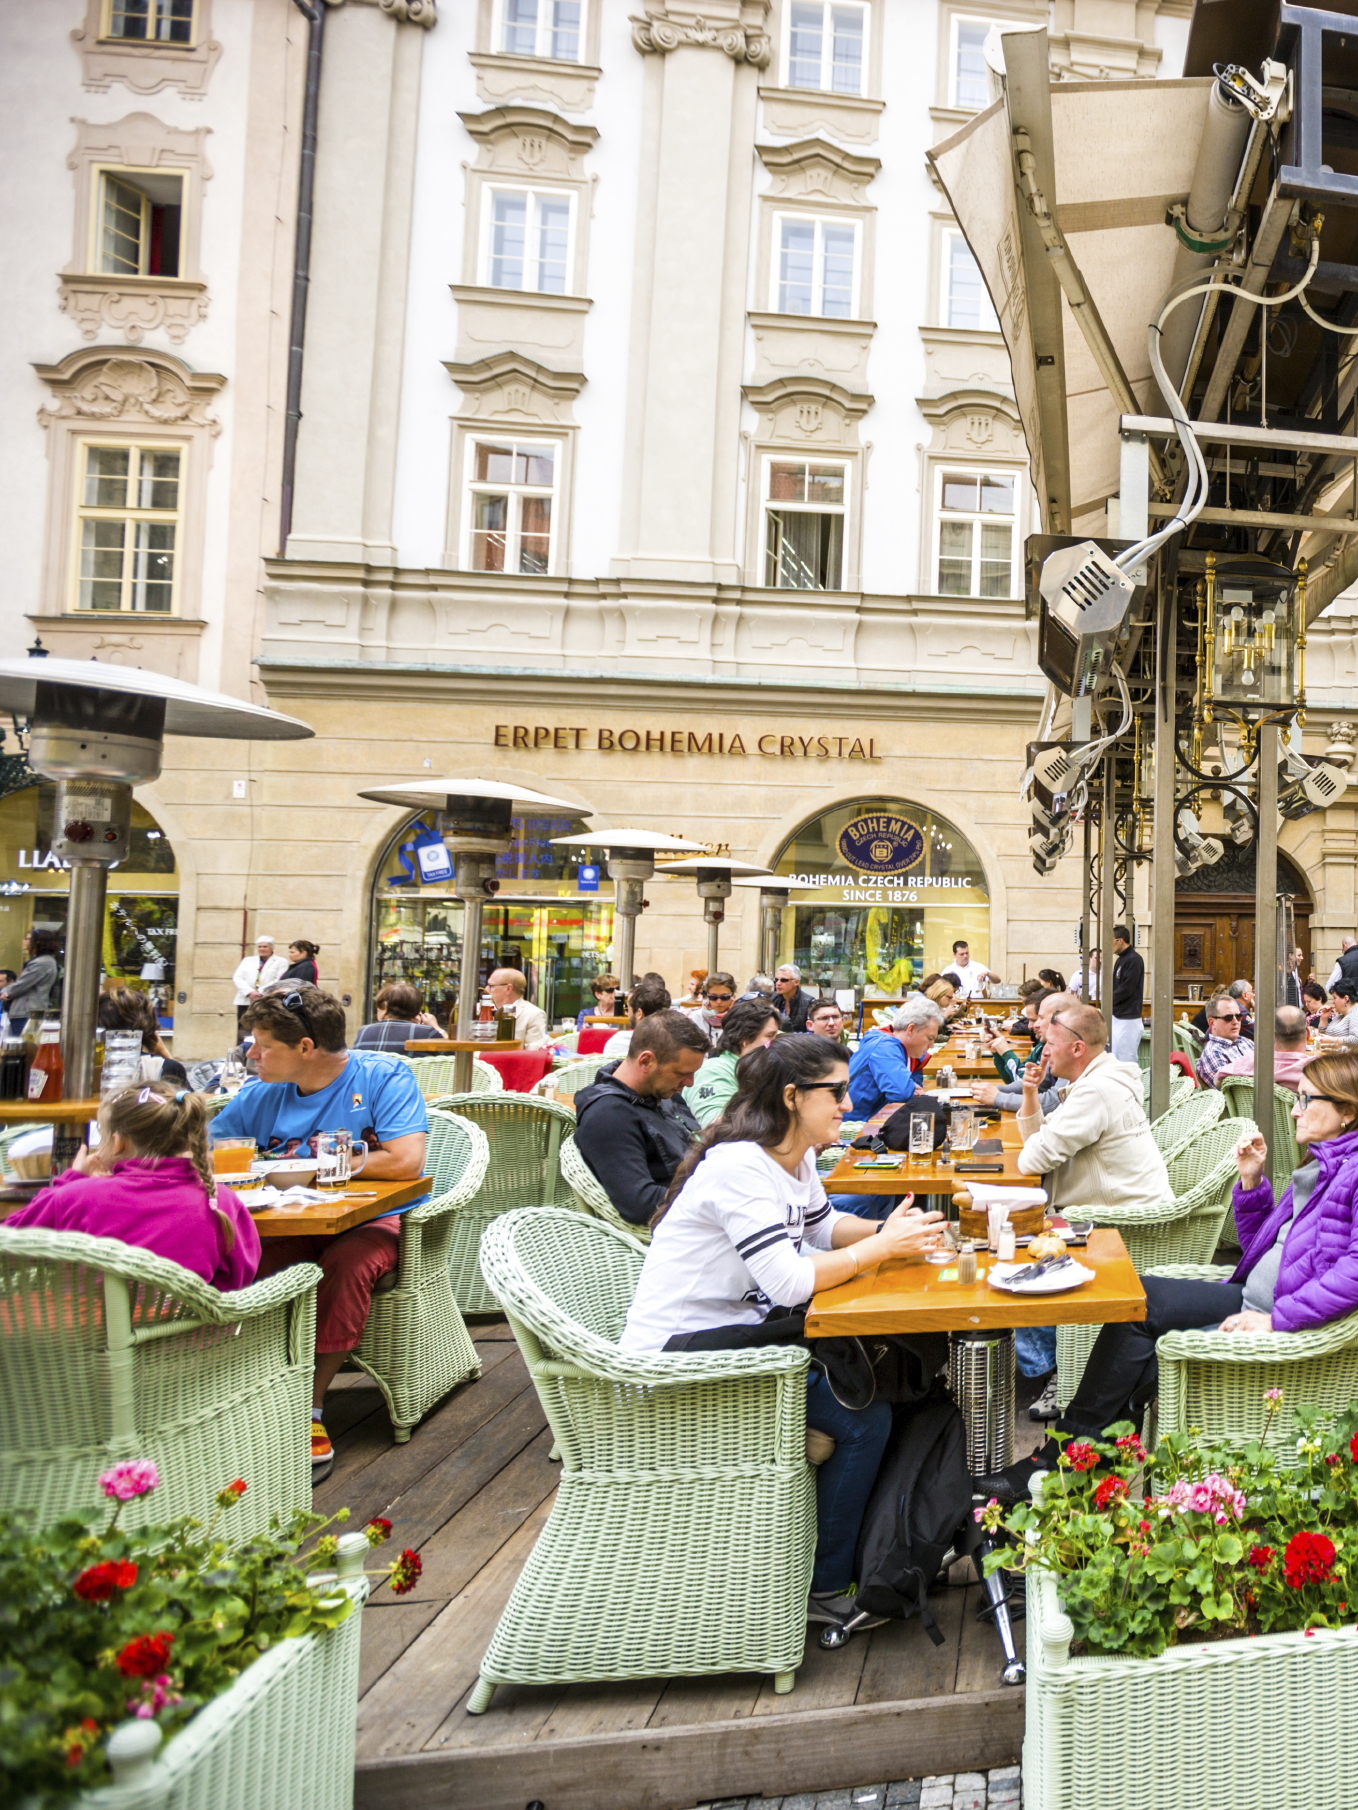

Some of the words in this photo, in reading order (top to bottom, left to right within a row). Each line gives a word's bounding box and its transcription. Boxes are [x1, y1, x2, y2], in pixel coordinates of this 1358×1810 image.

[494, 724, 587, 750] ERPET
[597, 728, 747, 754] BOHEMIA
[757, 734, 883, 760] CRYSTAL
[847, 818, 915, 842] BOHEMIA
[529, 838, 553, 848] Free
[855, 833, 876, 846] CZECH
[878, 832, 909, 848] REPUBLIC
[855, 859, 870, 869] LEAD
[870, 863, 896, 871] CRYSTAL
[896, 858, 911, 868] OVER
[858, 875, 904, 888] CZECH
[908, 876, 972, 888] REPUBLIC
[842, 890, 883, 901] SINCE
[886, 890, 918, 902] 1876
[146, 927, 164, 936] TAX
